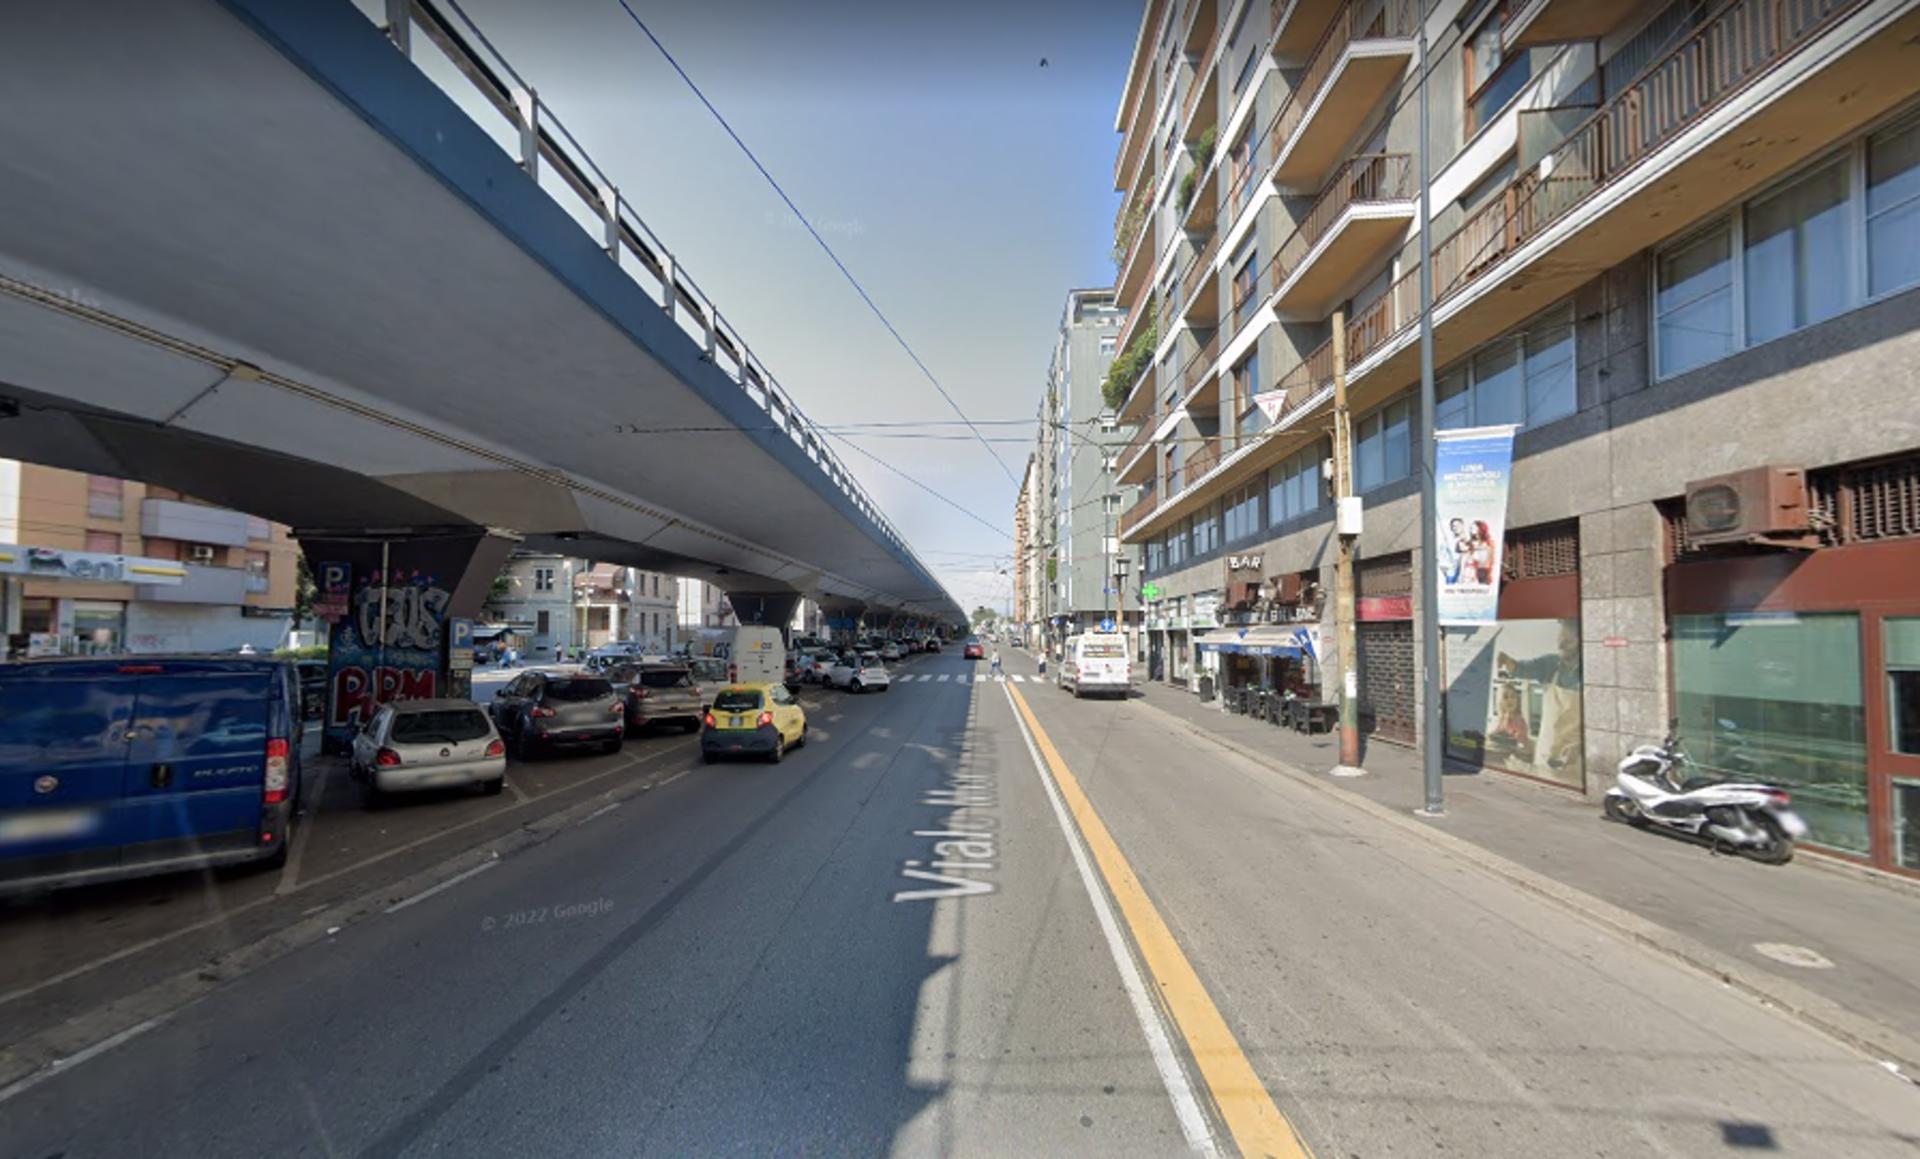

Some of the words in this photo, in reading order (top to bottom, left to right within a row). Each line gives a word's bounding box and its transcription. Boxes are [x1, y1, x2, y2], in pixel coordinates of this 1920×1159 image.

[1229, 555, 1261, 569] BAR
[325, 566, 344, 589] P
[454, 623, 468, 645] P
